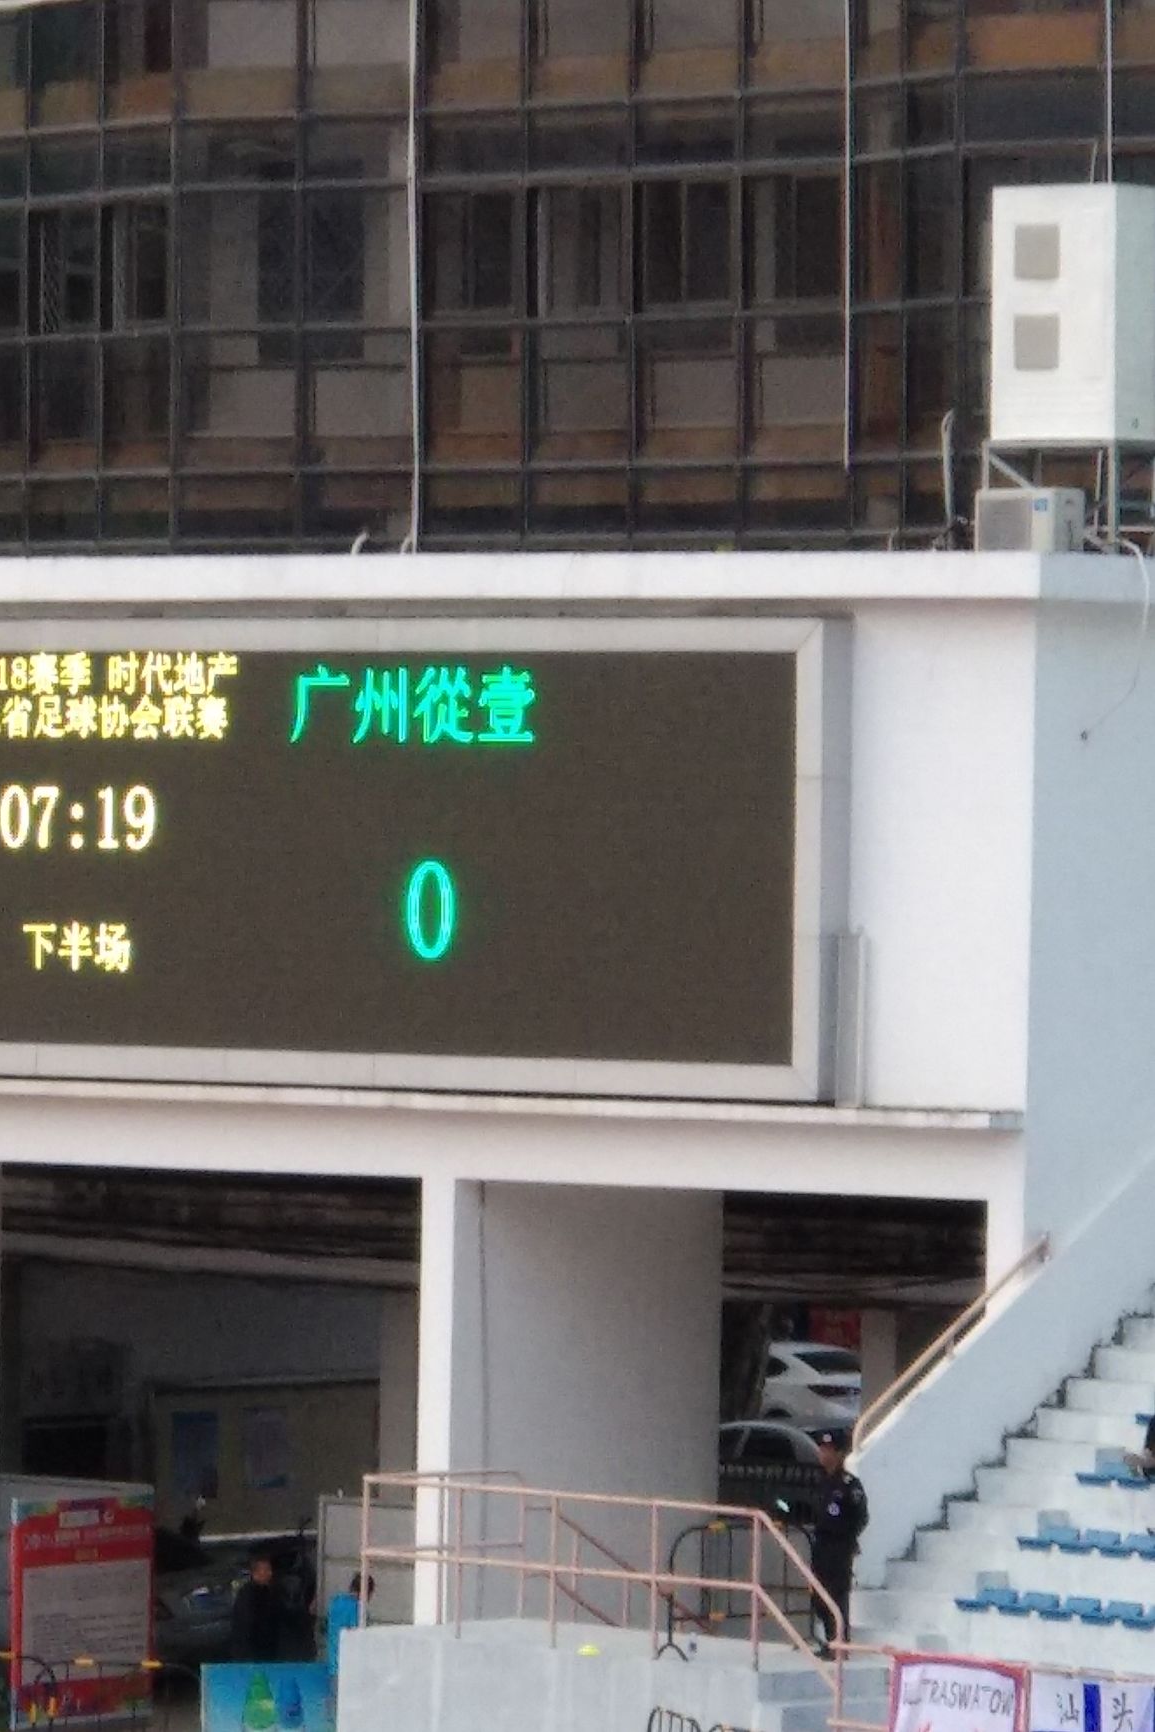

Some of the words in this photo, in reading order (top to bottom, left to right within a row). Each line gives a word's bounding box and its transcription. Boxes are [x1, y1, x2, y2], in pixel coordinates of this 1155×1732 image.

[107, 652, 239, 695] 时代地产
[289, 664, 536, 746] 广州從壹
[402, 859, 457, 960] 0
[22, 920, 132, 973] 下半场
